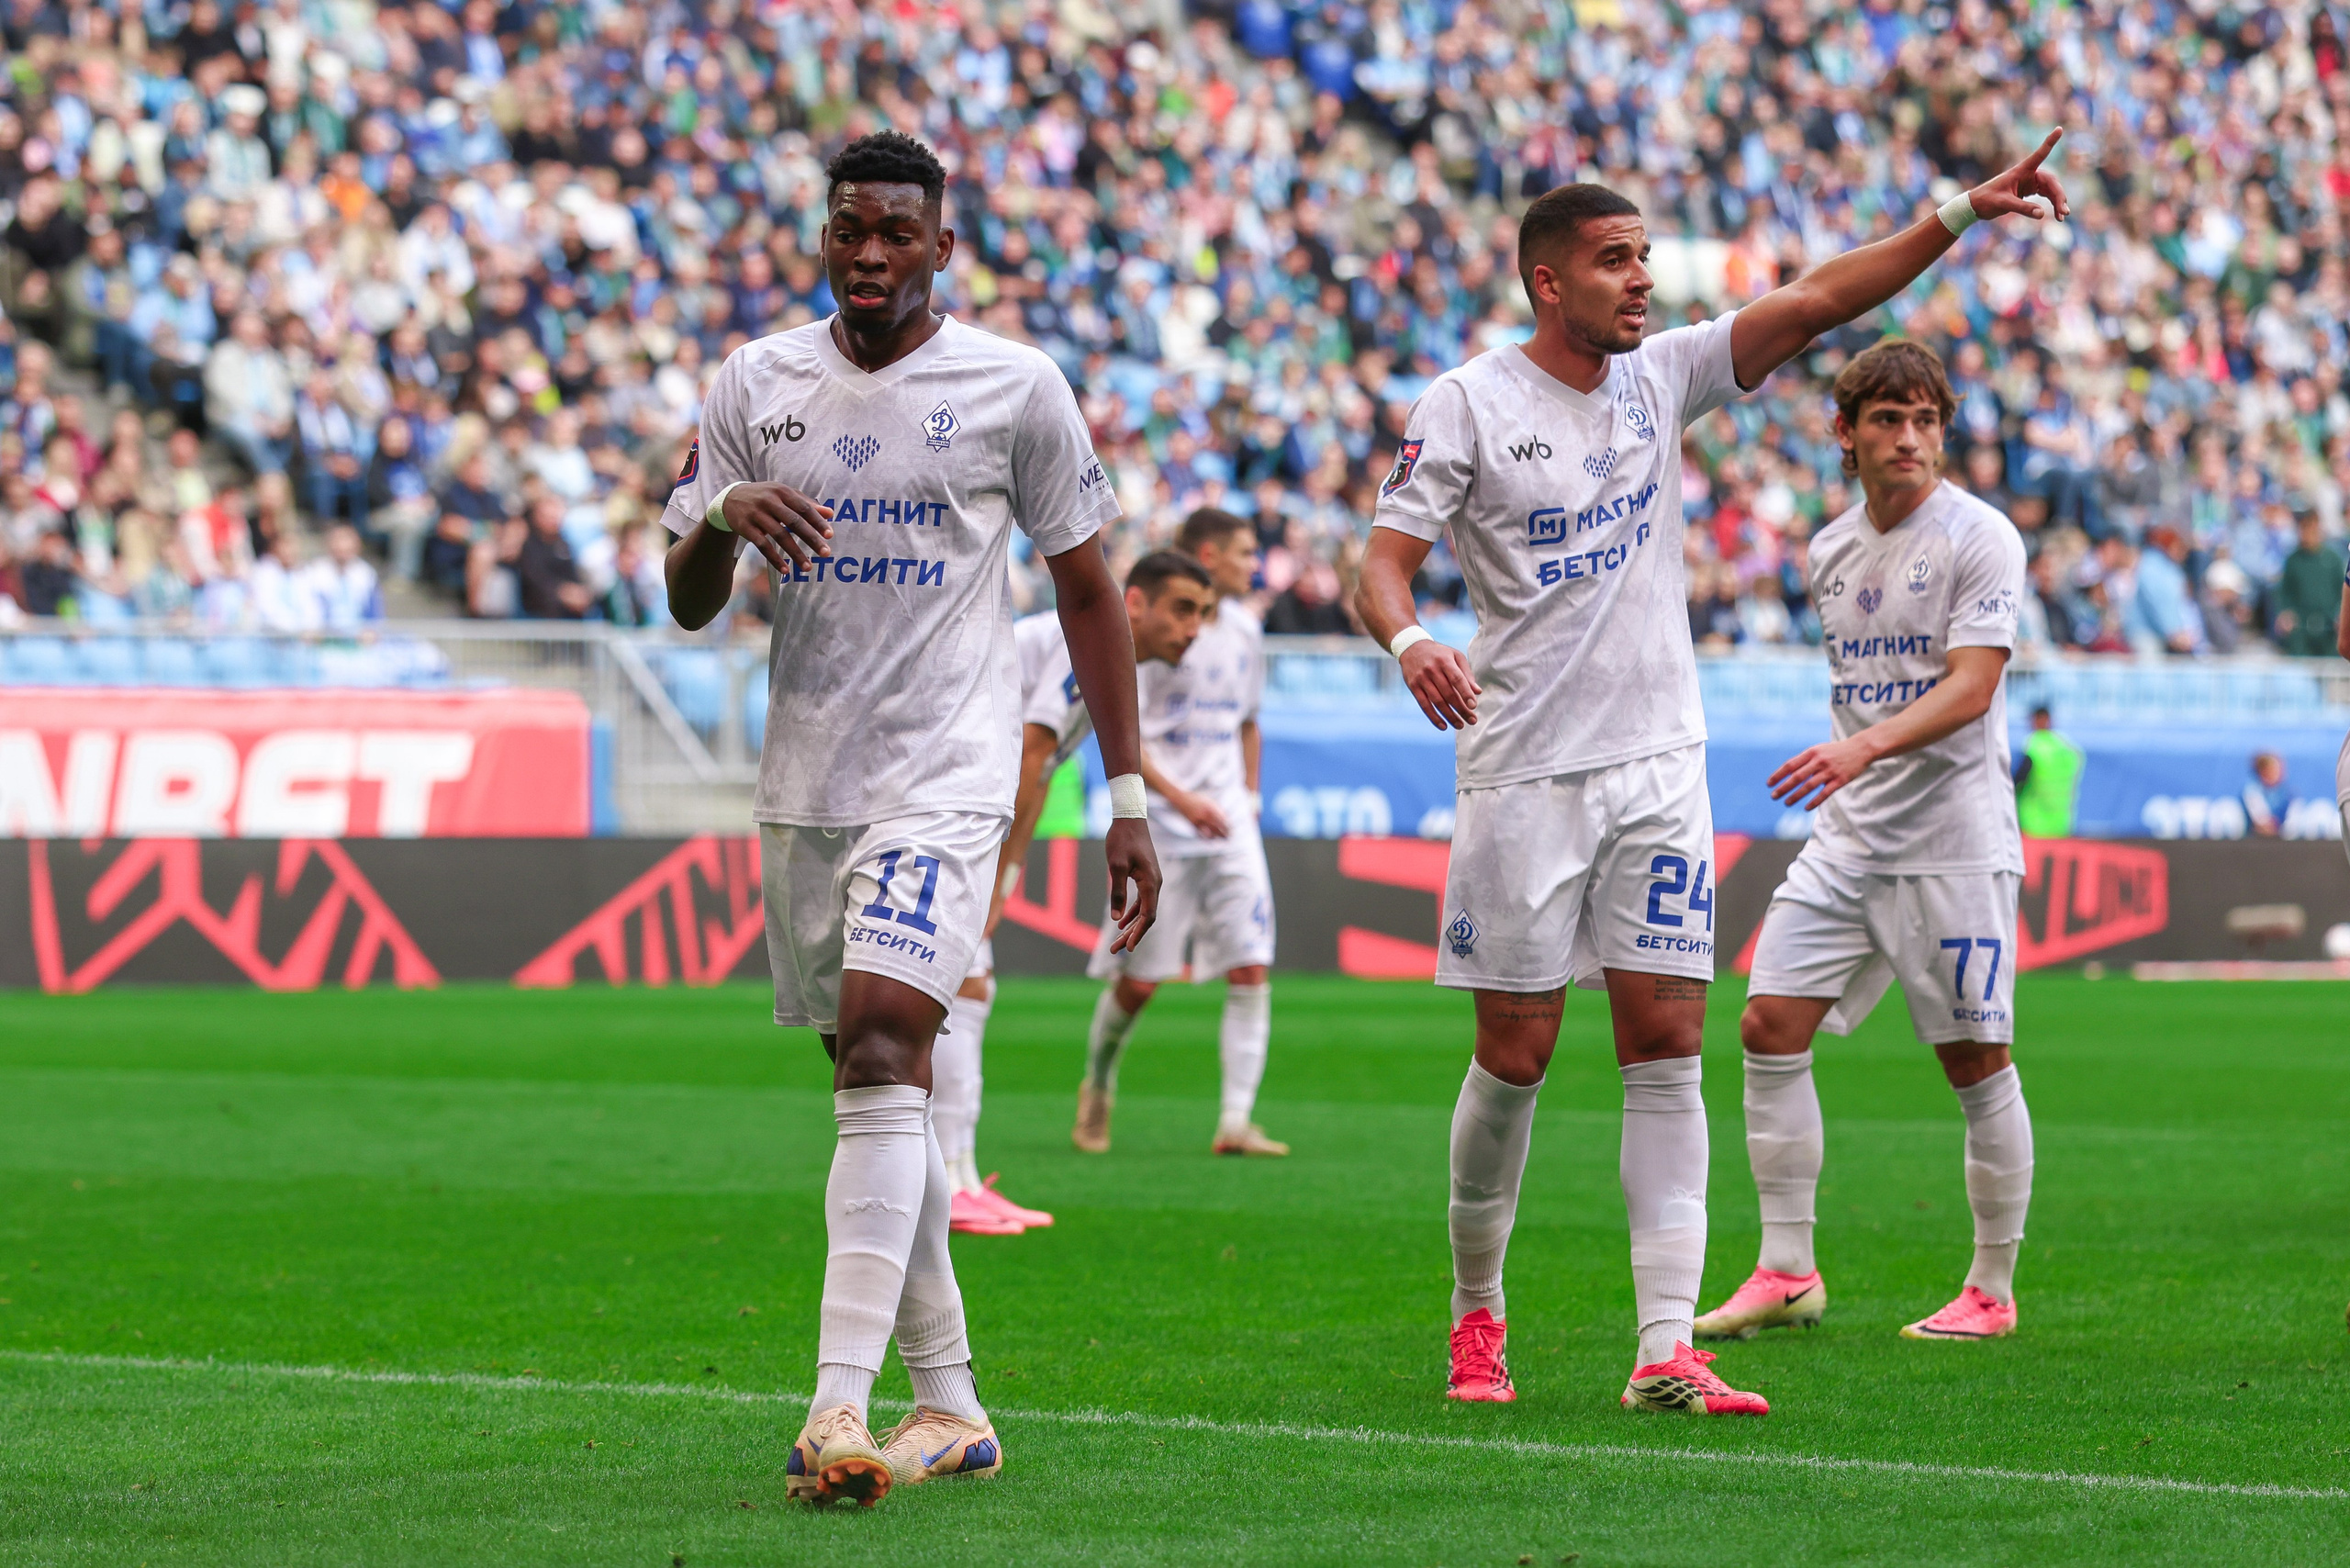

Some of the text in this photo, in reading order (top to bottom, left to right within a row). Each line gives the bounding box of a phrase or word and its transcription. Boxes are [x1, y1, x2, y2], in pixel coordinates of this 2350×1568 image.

[760, 414, 806, 446] wb
[1507, 434, 1552, 462] wb
[1842, 634, 1931, 659] МАГНИТ
[1831, 678, 1938, 705] ЕТСИТИ
[860, 850, 941, 937] 11
[1646, 854, 1713, 932] 24
[849, 927, 936, 964] БЕТСИТИ
[1940, 937, 2002, 1002] 77
